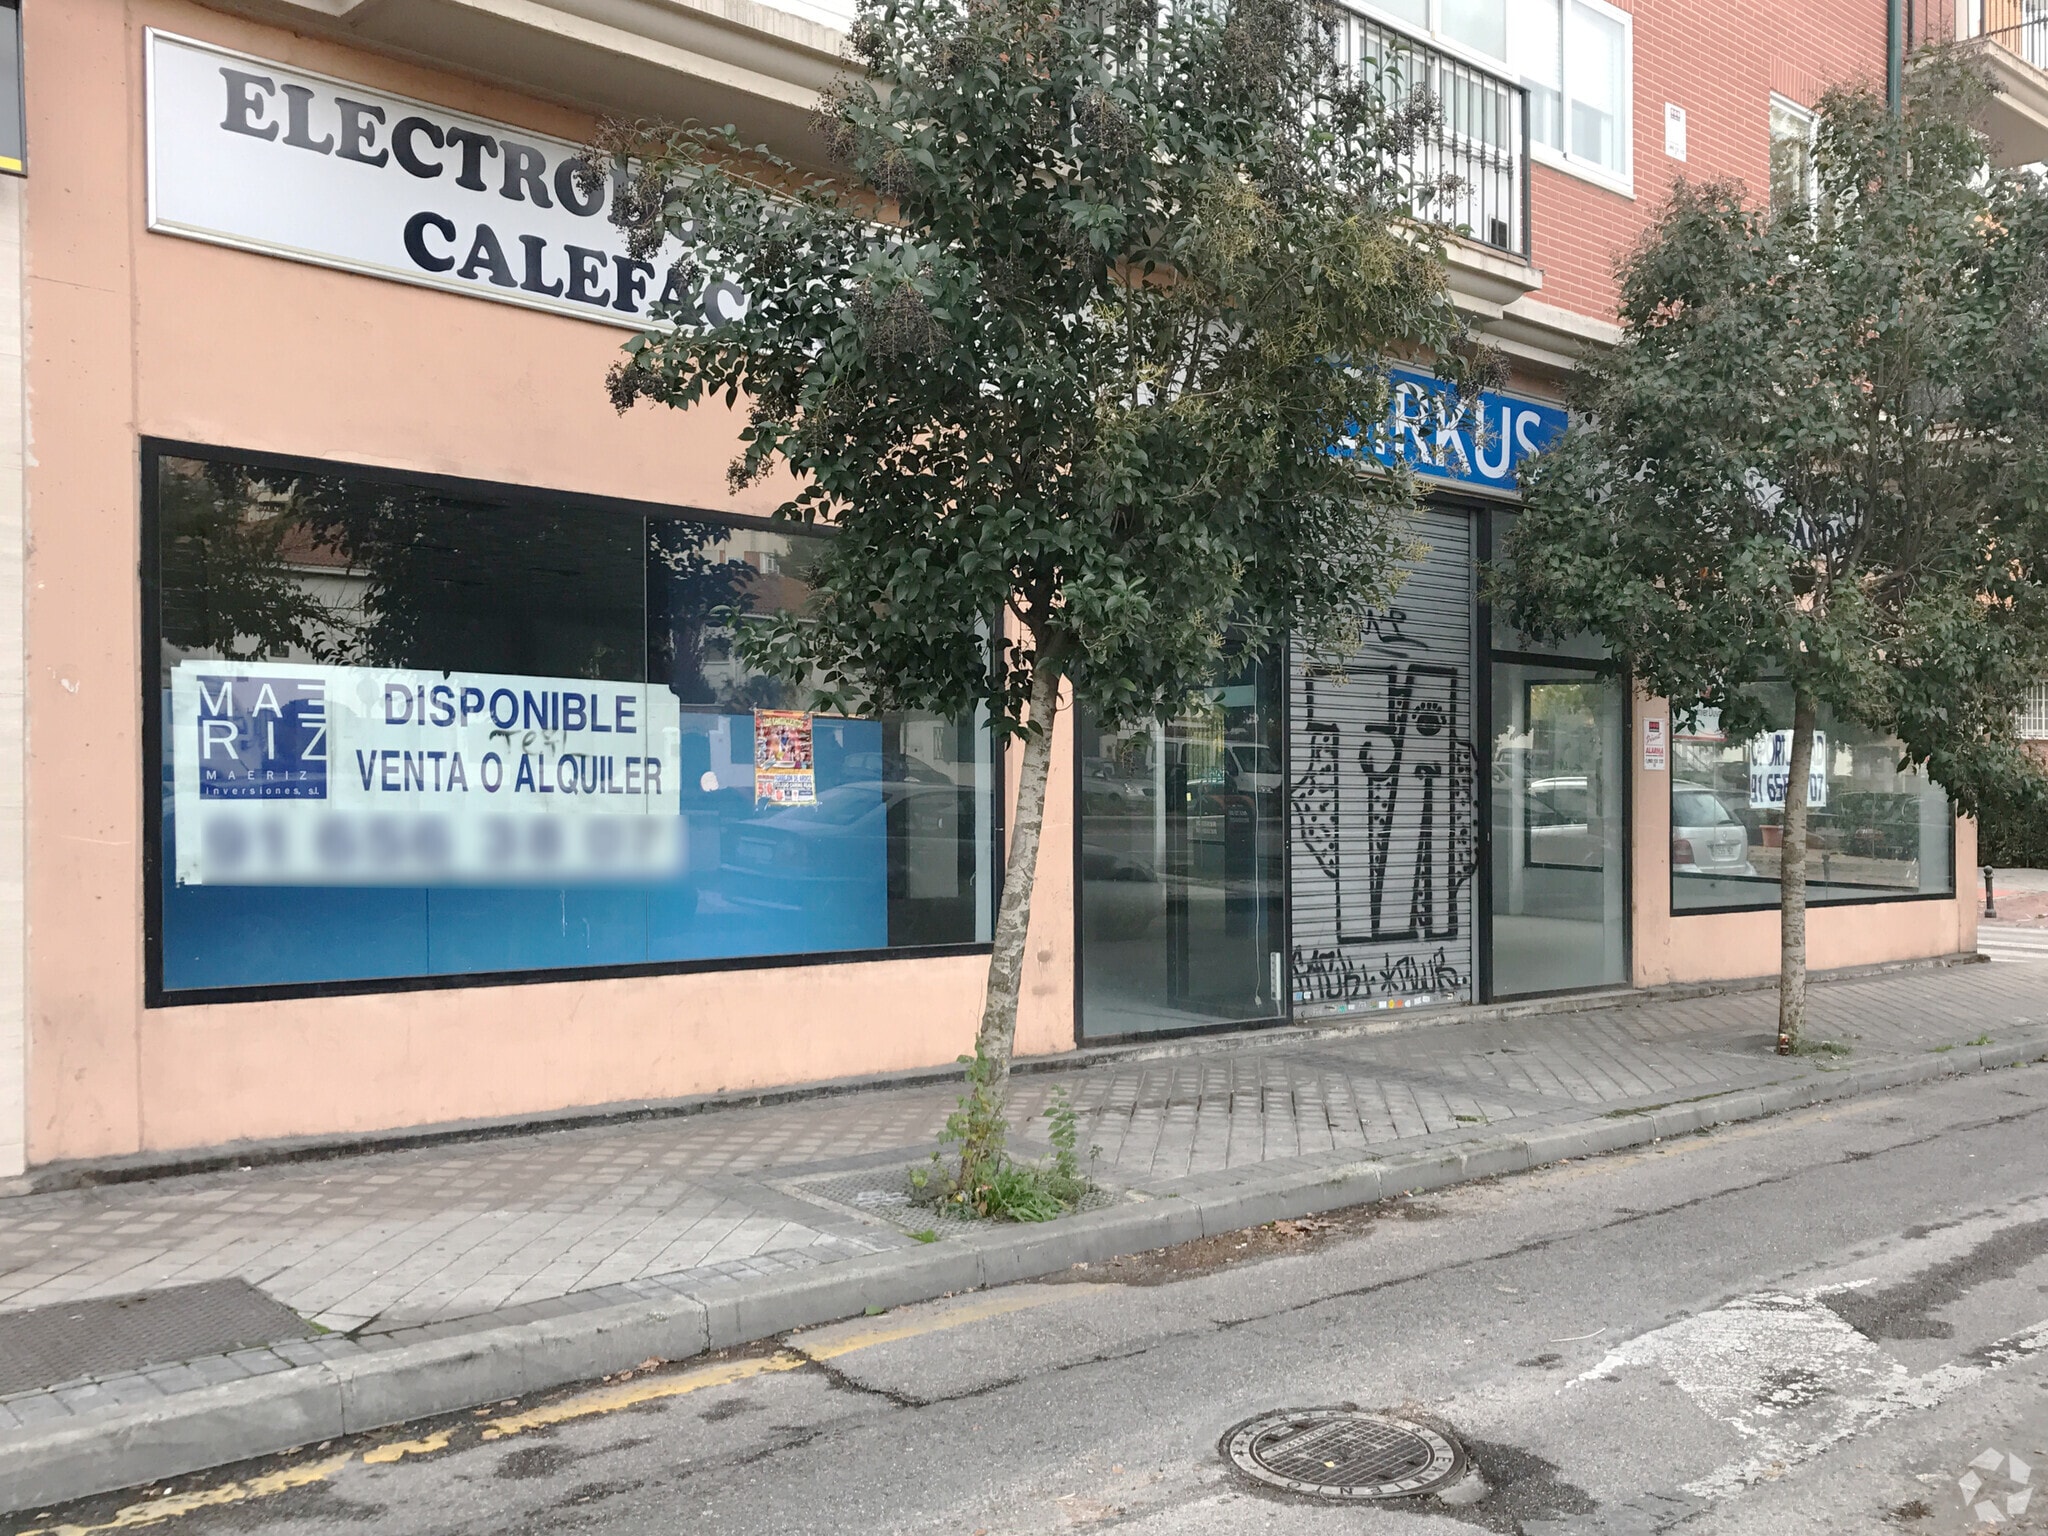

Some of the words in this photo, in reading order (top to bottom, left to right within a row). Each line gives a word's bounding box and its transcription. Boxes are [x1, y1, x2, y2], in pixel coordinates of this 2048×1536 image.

[384, 683, 637, 735] DISPONIBLE
[202, 720, 328, 760] RIZ
[206, 770, 308, 781] MAERIZ
[356, 749, 468, 792] VENTA
[481, 752, 503, 793] O
[515, 754, 663, 796] ALQUILER
